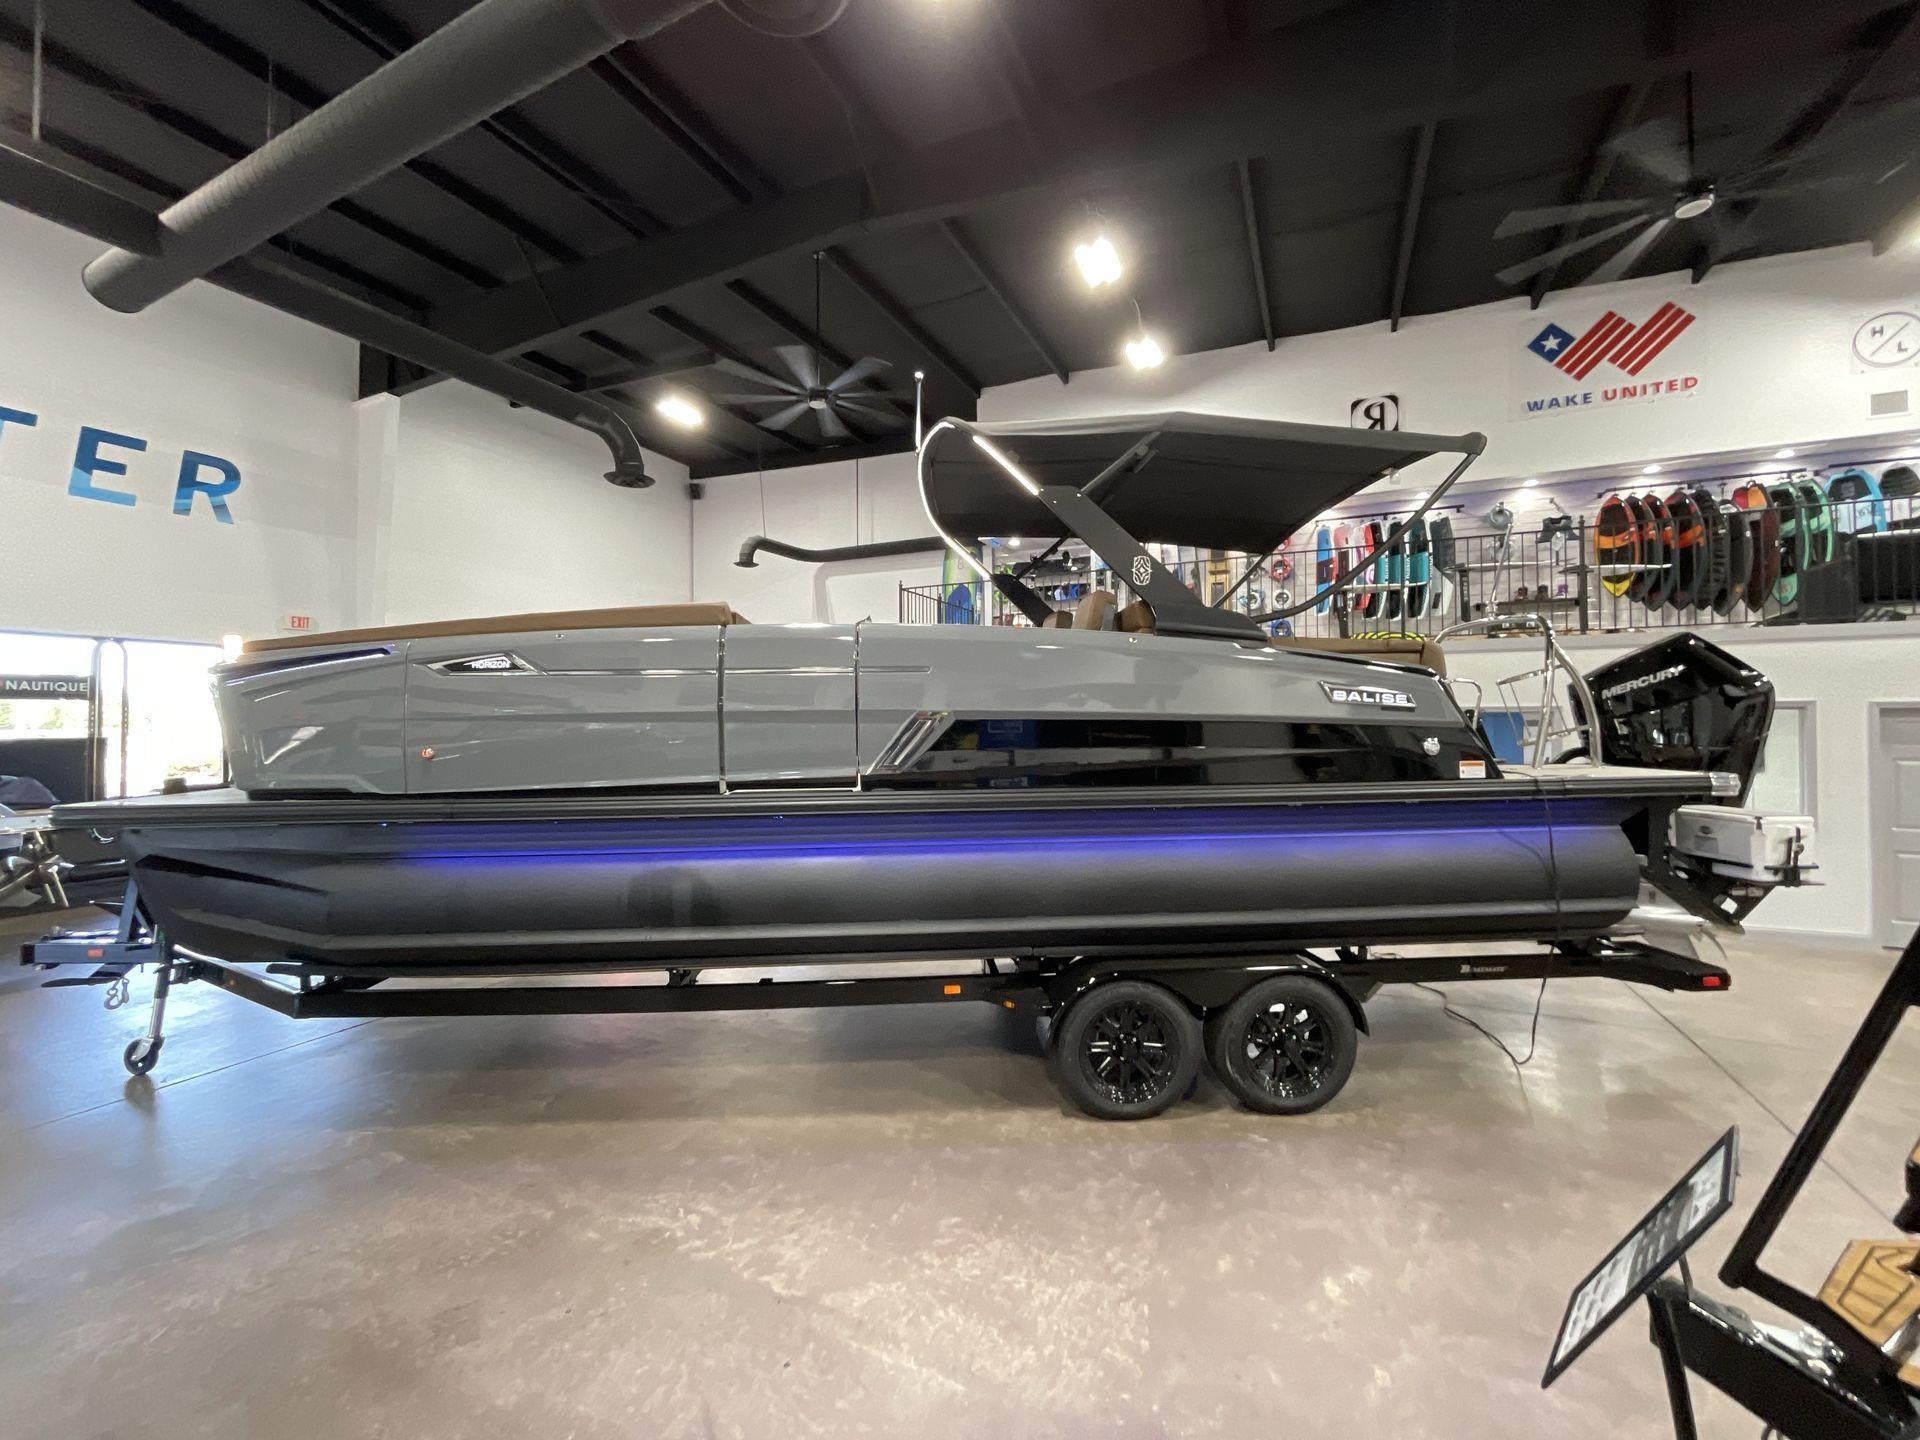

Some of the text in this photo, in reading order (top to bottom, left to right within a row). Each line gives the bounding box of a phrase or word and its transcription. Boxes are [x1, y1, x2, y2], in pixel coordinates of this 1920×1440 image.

[1526, 376, 1698, 412] WAKE UNITED
[291, 615, 311, 629] EXIT
[471, 659, 511, 669] HORIZON
[5, 680, 88, 692] NAUTIQUE
[1601, 664, 1687, 700] MERCURY
[1332, 690, 1408, 704] BALISE
